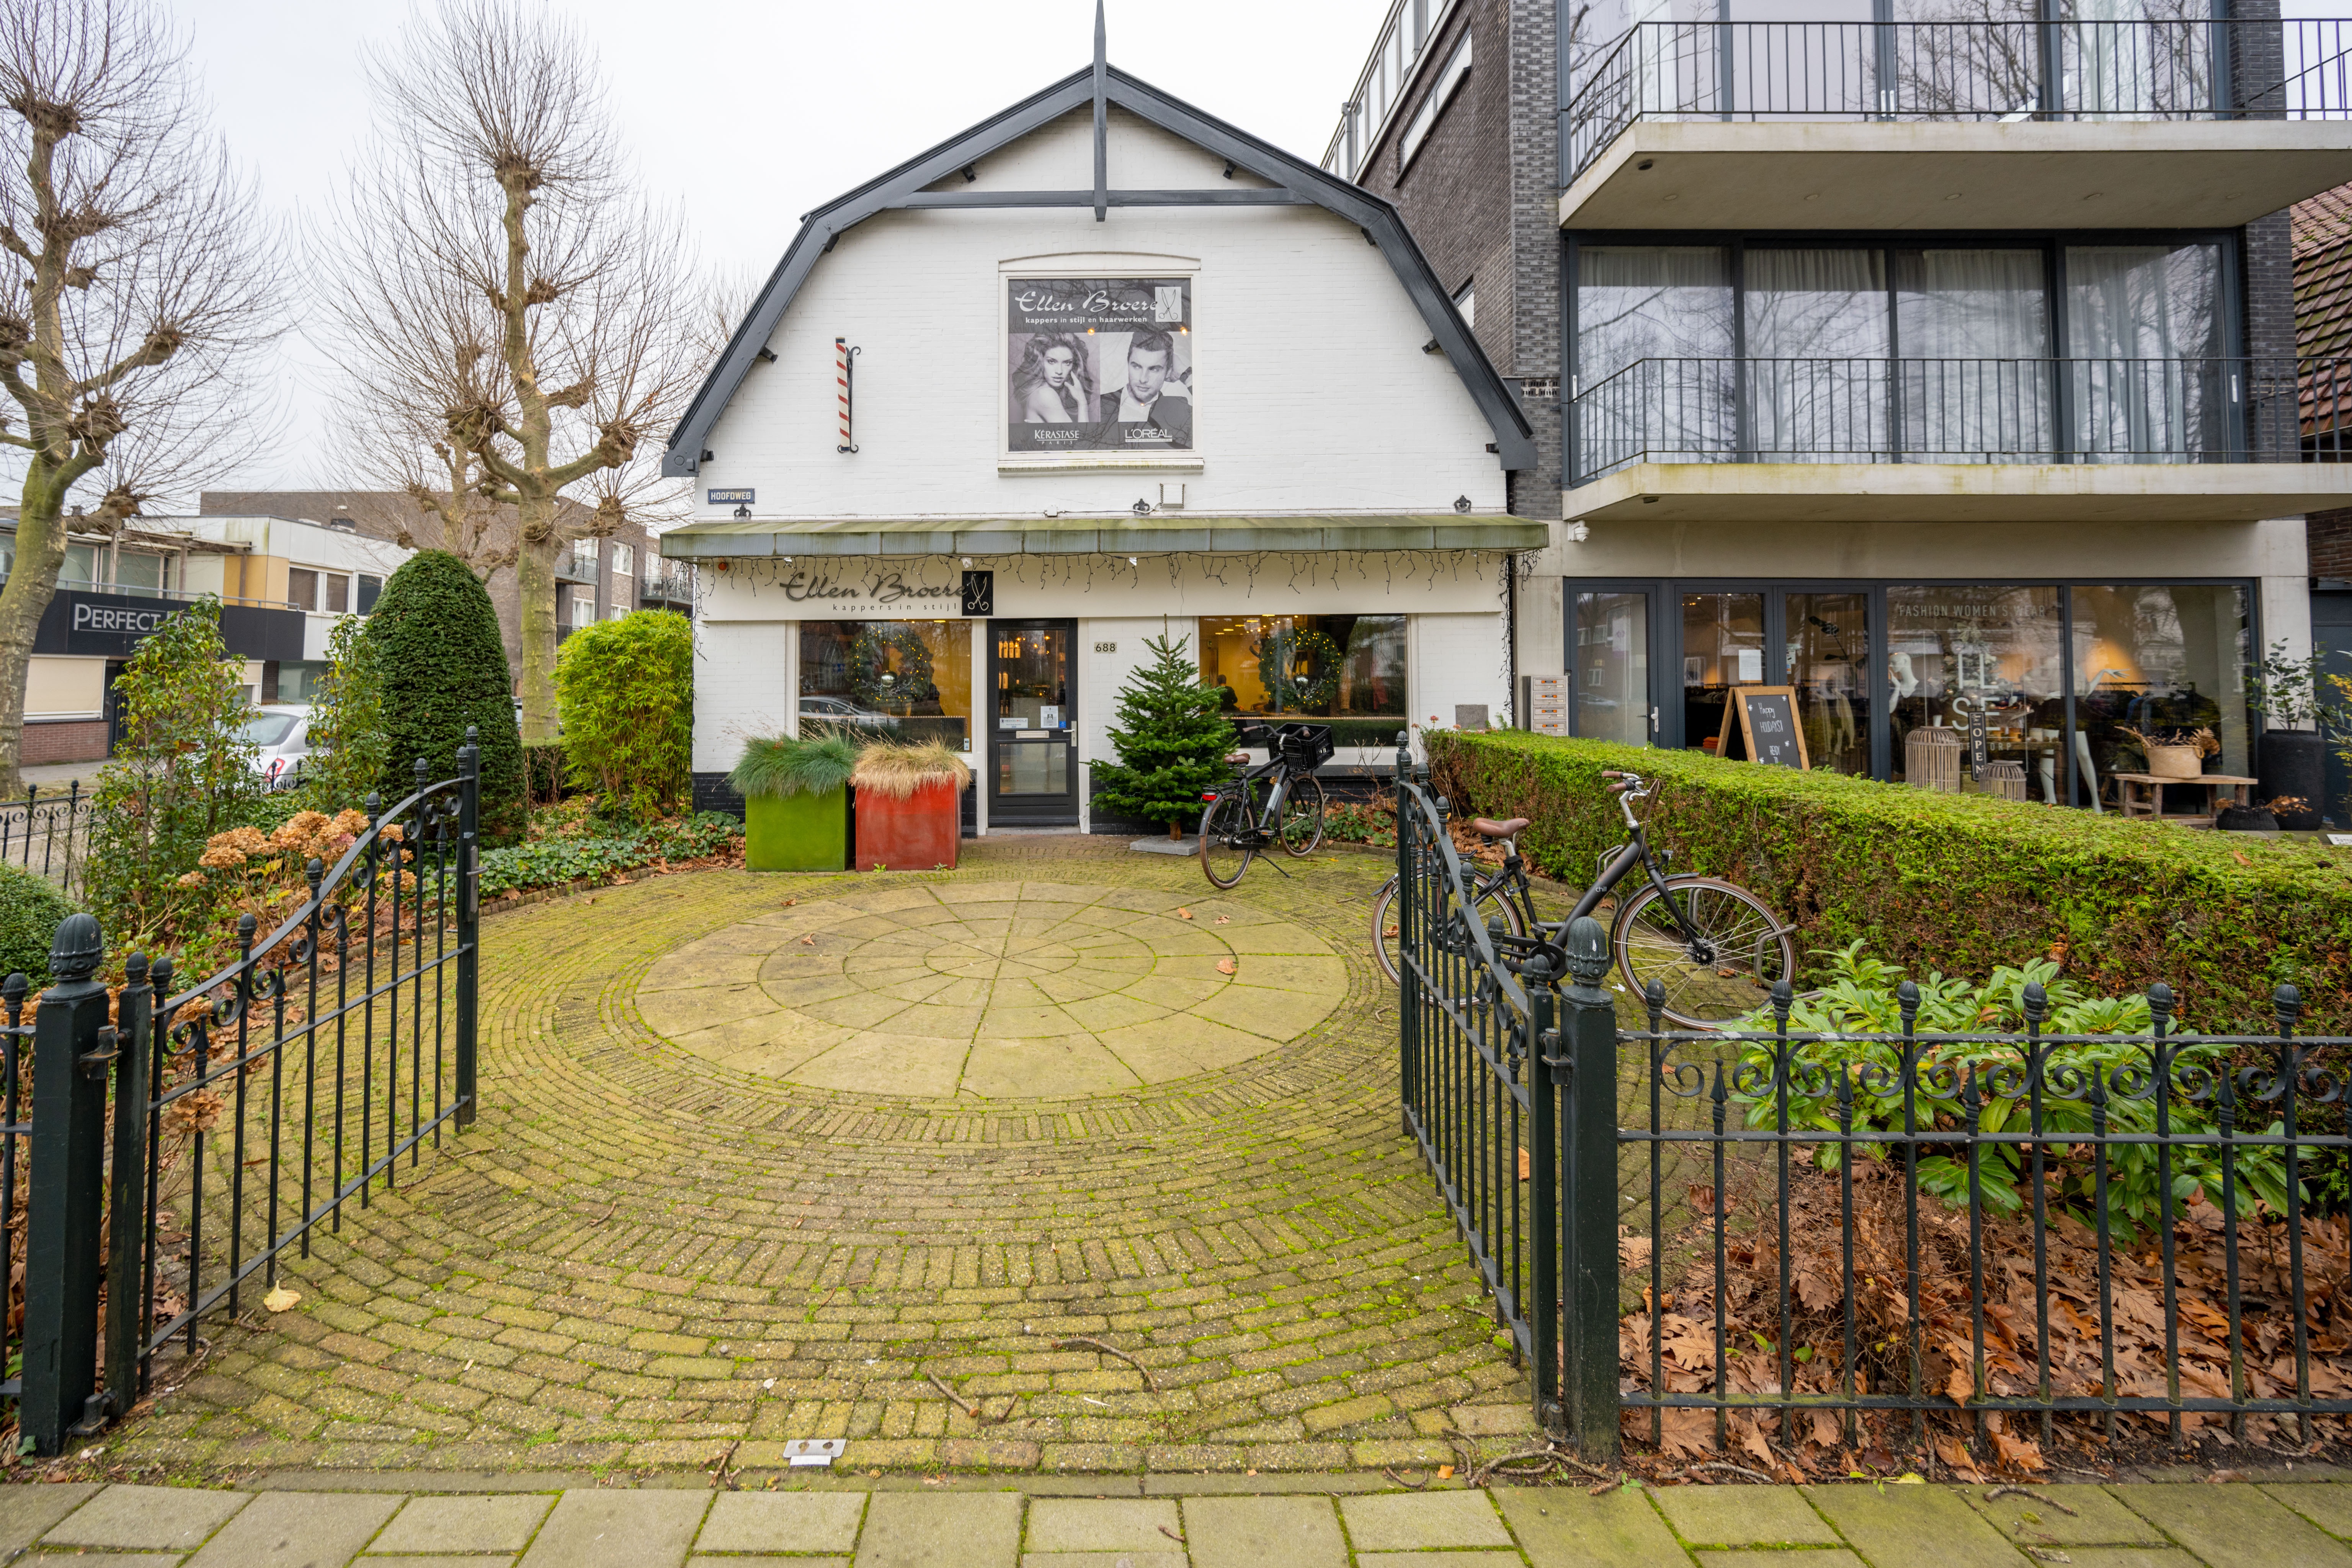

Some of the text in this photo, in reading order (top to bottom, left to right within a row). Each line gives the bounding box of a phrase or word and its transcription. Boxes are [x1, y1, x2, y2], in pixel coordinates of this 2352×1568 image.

[1015, 291, 1158, 312] Ellen Broere
[1035, 430, 1079, 439] KÉRASTASE
[1125, 428, 1172, 439] L'ORÉAL
[711, 492, 751, 500] HOOFDWEG
[779, 572, 969, 603] Ellen Broere
[924, 603, 956, 611] stijl
[1900, 605, 1947, 617] FASHION
[1953, 605, 2007, 617] WOMEN'S
[74, 603, 161, 631] PERFECT
[1096, 644, 1115, 652] 688
[1973, 728, 1984, 774] OPEN
